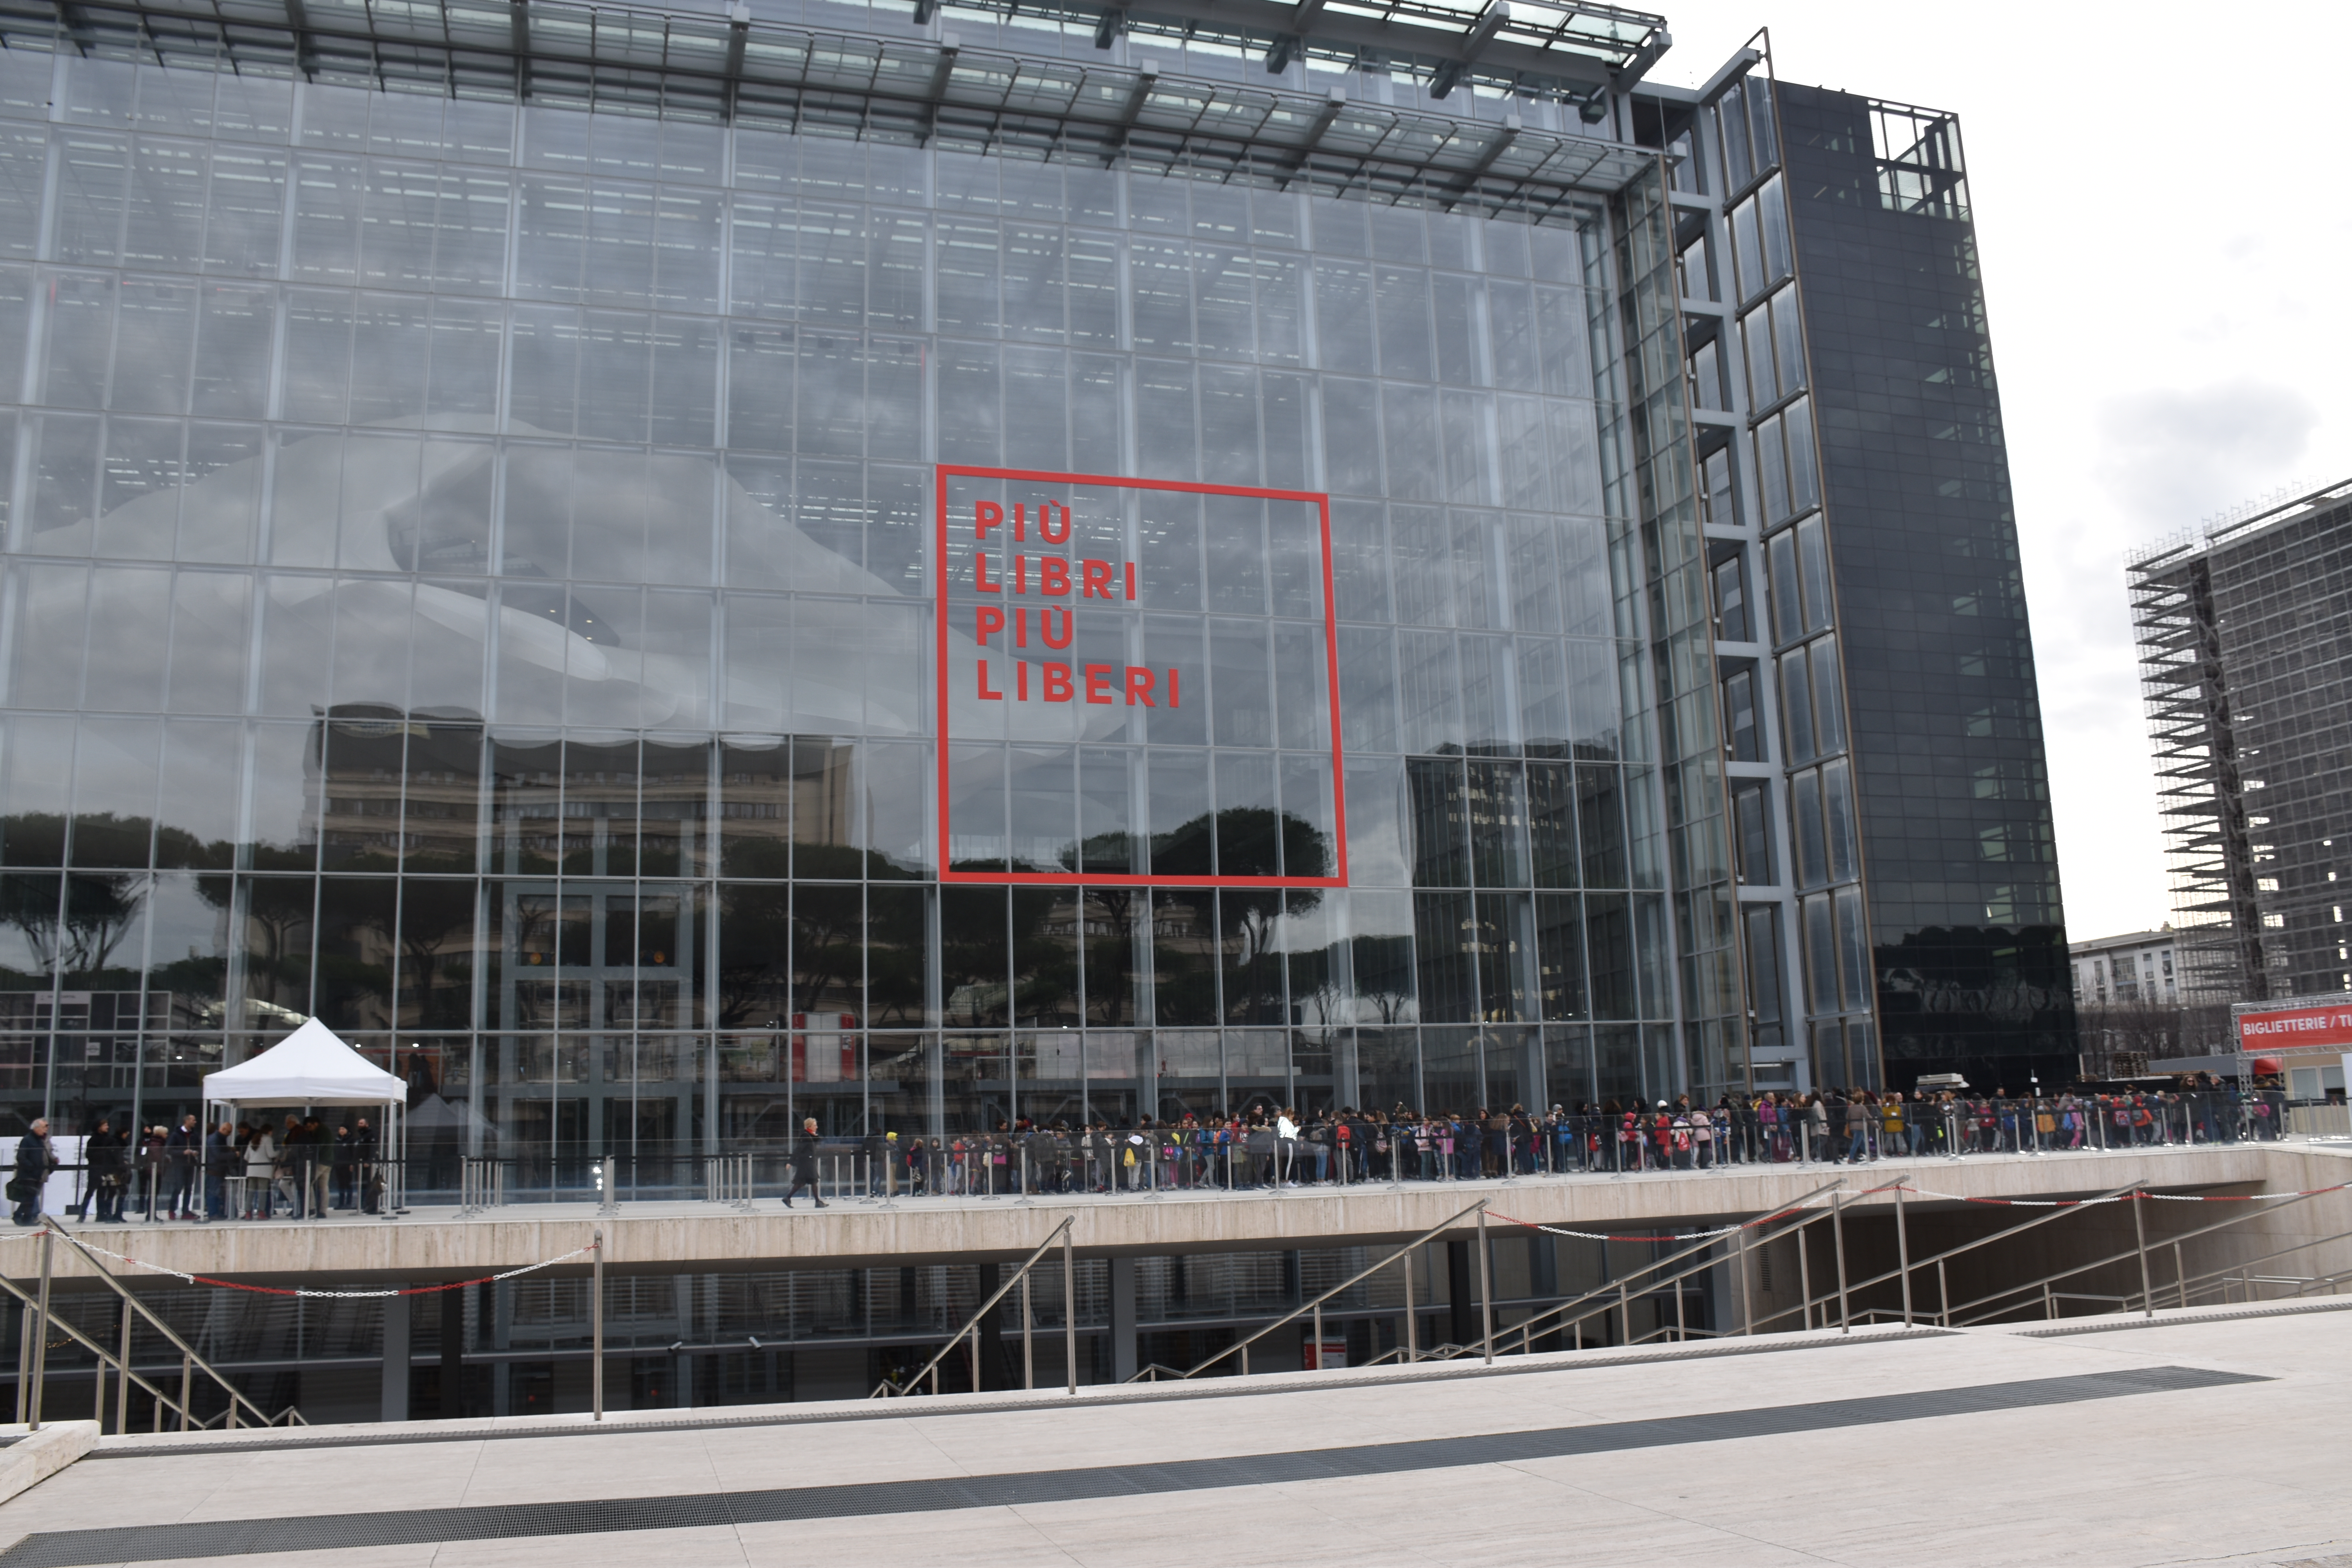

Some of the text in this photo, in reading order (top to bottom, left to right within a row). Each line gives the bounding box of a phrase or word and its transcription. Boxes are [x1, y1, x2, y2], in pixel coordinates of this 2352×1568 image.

[975, 500, 1071, 544] PIÙ
[976, 552, 1136, 600] LIBRI
[976, 605, 1073, 650] PIÙ
[977, 659, 1179, 708] LIBERI
[2243, 1016, 2327, 1035] BIGLIETTERIE
[2338, 1014, 2352, 1027] TI
